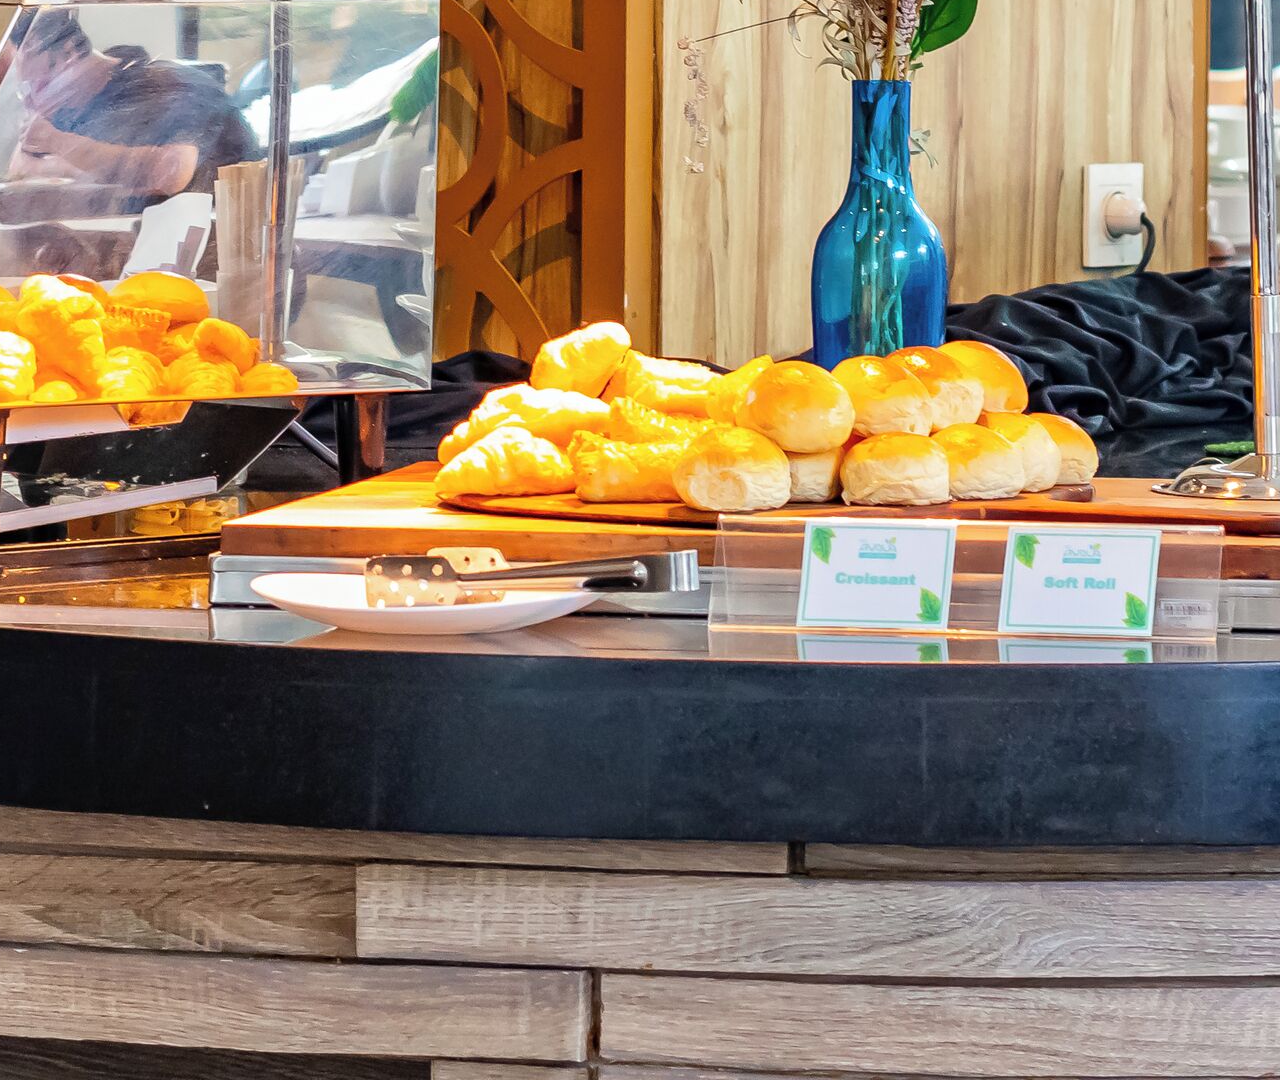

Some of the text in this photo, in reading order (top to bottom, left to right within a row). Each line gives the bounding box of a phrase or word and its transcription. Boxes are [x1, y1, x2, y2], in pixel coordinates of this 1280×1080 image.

[835, 572, 916, 586] Croissant
[1044, 576, 1116, 590] Soft Roll
